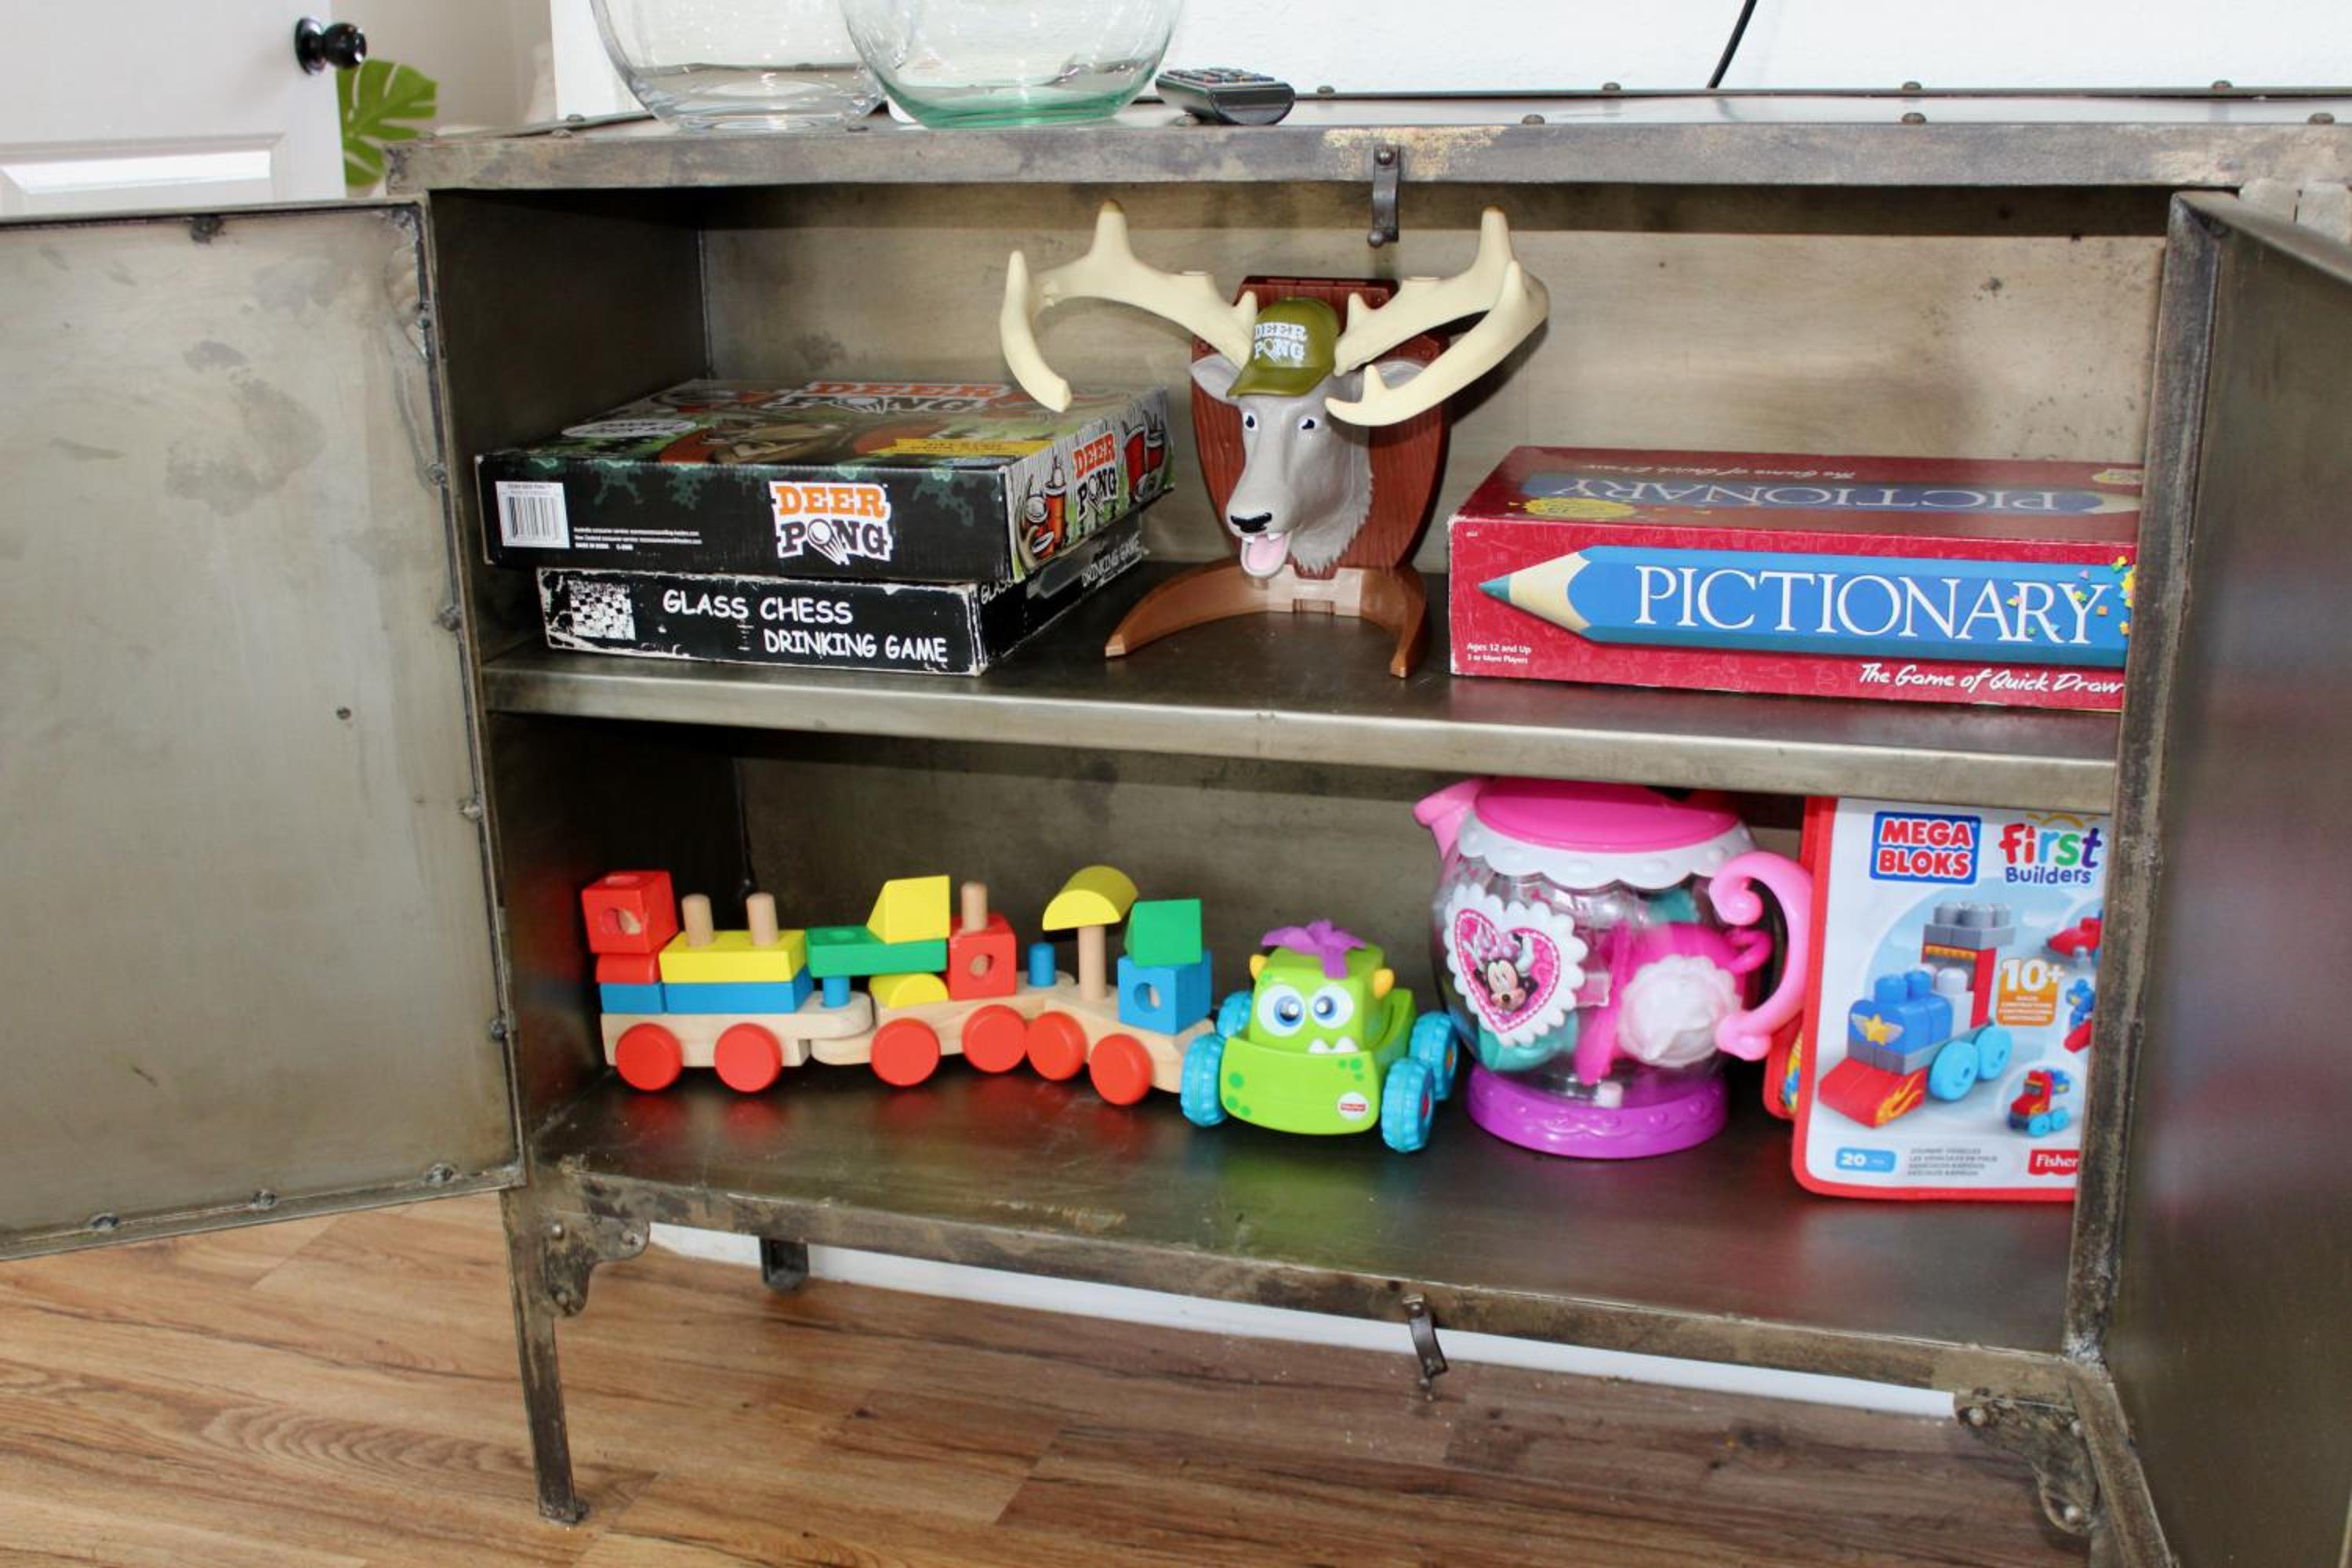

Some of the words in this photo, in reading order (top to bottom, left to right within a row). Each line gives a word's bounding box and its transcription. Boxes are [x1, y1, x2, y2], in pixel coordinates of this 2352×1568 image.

[770, 395, 984, 414] PONG
[803, 382, 1000, 398] DEER
[1073, 433, 1116, 480] DEER
[775, 485, 886, 518] DEER
[1077, 468, 1117, 518] PONG
[1551, 478, 2060, 510] PICTIONARY
[780, 518, 888, 558] PONG
[662, 589, 749, 619] GLASS
[759, 597, 853, 625] CHESS
[1635, 565, 2112, 644] PICTIONARY
[763, 629, 877, 659] DRINKING
[884, 636, 949, 663] GAME
[1467, 642, 1487, 653] Ages
[1490, 644, 1500, 652] 12
[1501, 644, 1518, 653] and
[1519, 645, 1531, 655] Up
[1859, 663, 1892, 684] The
[1894, 667, 1957, 688] Game
[1960, 670, 1991, 694] of
[1991, 669, 2049, 693] Quick
[2050, 673, 2125, 694] Draw
[1881, 820, 1972, 847] MEGA
[1998, 822, 2102, 869] first
[1878, 849, 1971, 877] BLOKS
[2005, 866, 2092, 884] Builders
[2001, 959, 2066, 992] 10+
[1842, 1152, 1867, 1167] 20
[2036, 1153, 2078, 1168] Fisher
